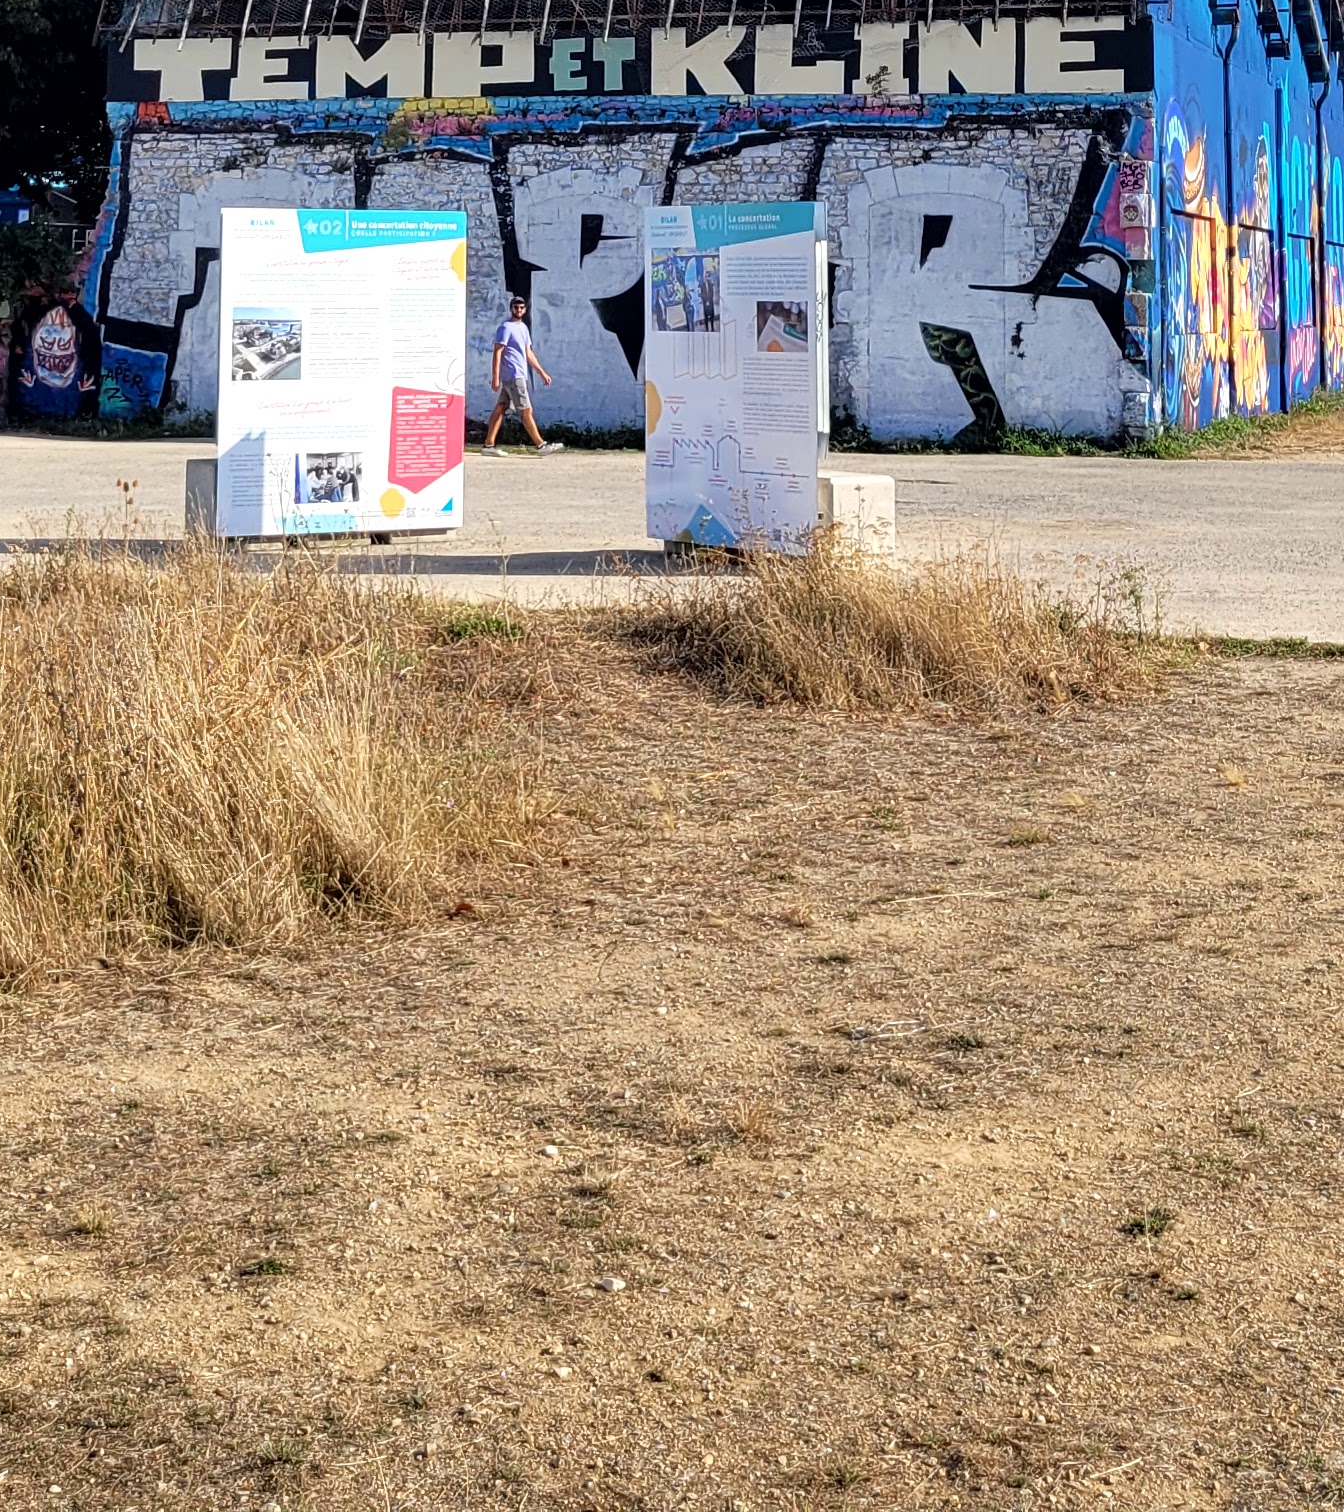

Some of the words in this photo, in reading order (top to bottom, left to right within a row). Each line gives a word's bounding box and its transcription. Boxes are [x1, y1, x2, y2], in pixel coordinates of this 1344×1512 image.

[133, 31, 535, 102] TEMP
[549, 36, 636, 92] ET
[651, 16, 1125, 96] KLINE
[737, 213, 781, 223] concertation
[319, 220, 342, 236] 02
[351, 220, 367, 230] Une
[368, 220, 418, 230] concertation
[419, 221, 458, 231] citoyenne
[351, 229, 377, 237] QUELLE
[379, 230, 430, 238] PARTICIPATION
